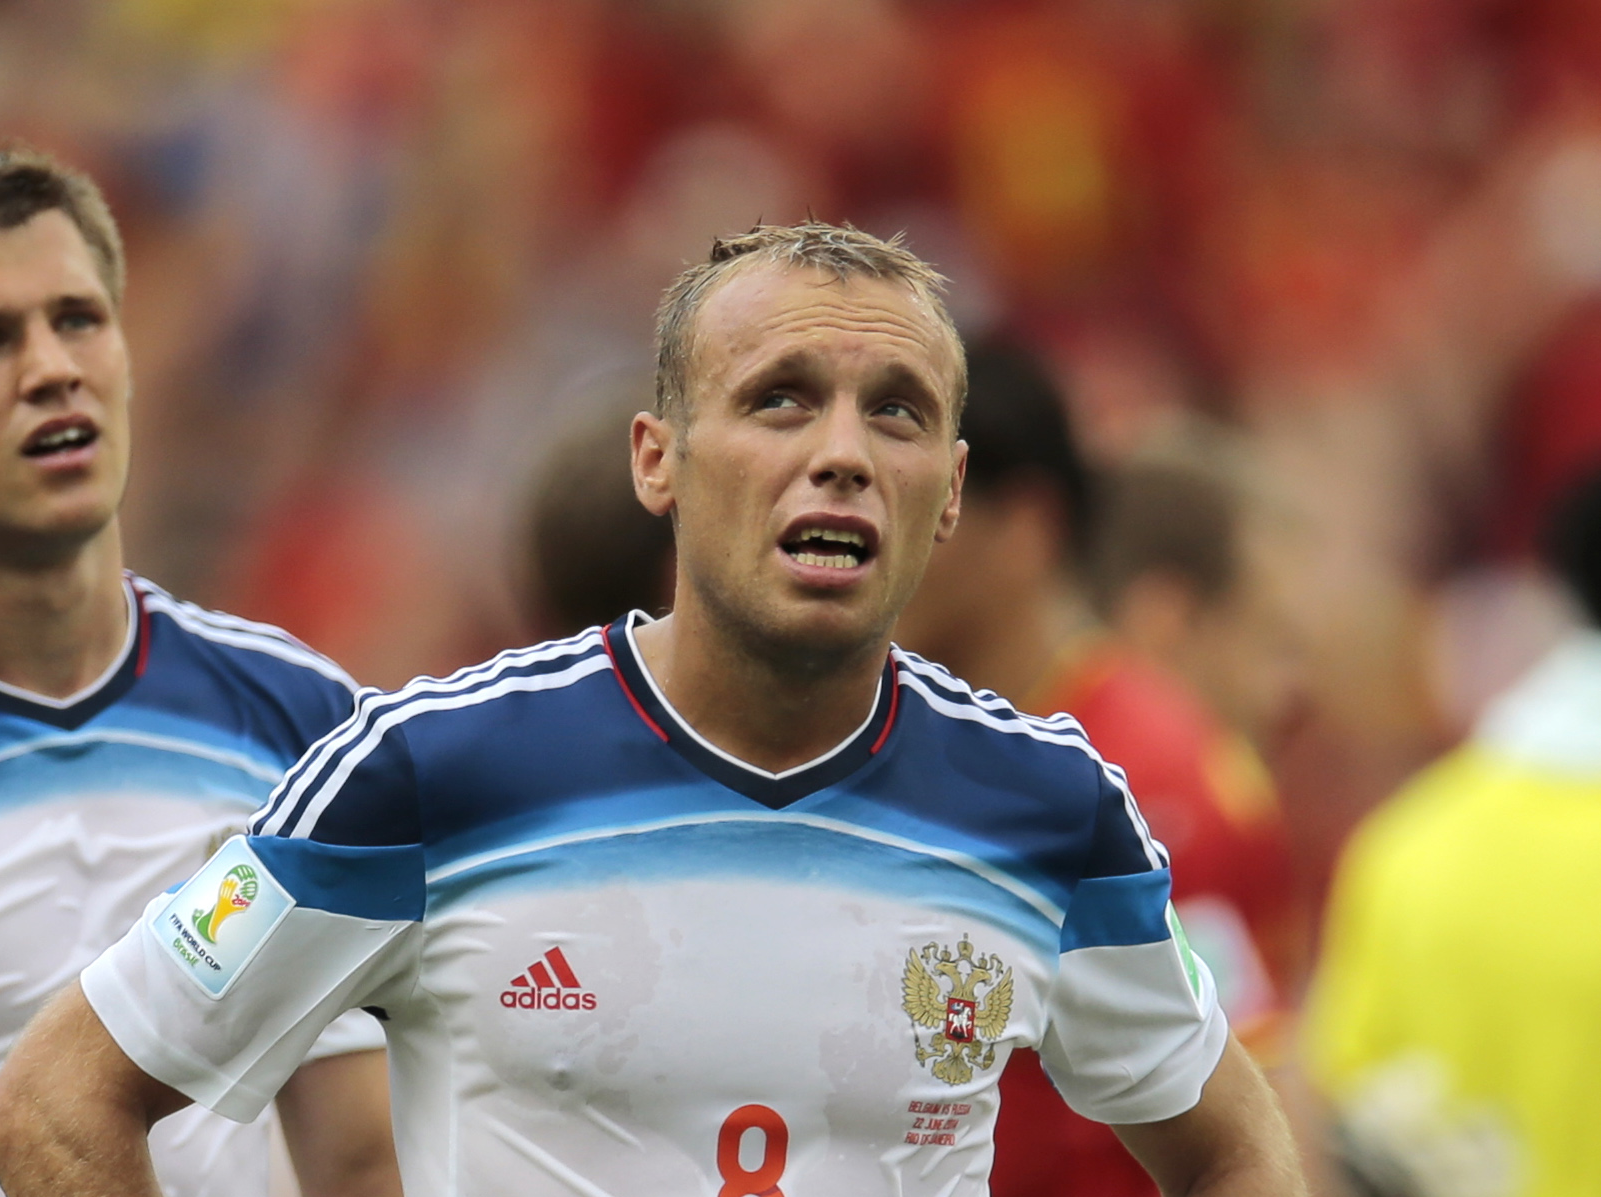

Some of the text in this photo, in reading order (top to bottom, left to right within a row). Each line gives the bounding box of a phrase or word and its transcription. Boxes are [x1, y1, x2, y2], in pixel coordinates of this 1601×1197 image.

[168, 912, 222, 972] FIFA WORLD CUP
[500, 986, 597, 1010] adidas
[912, 1117, 925, 1129] 22
[925, 1118, 944, 1130] JUNE
[904, 1131, 920, 1144] RIO
